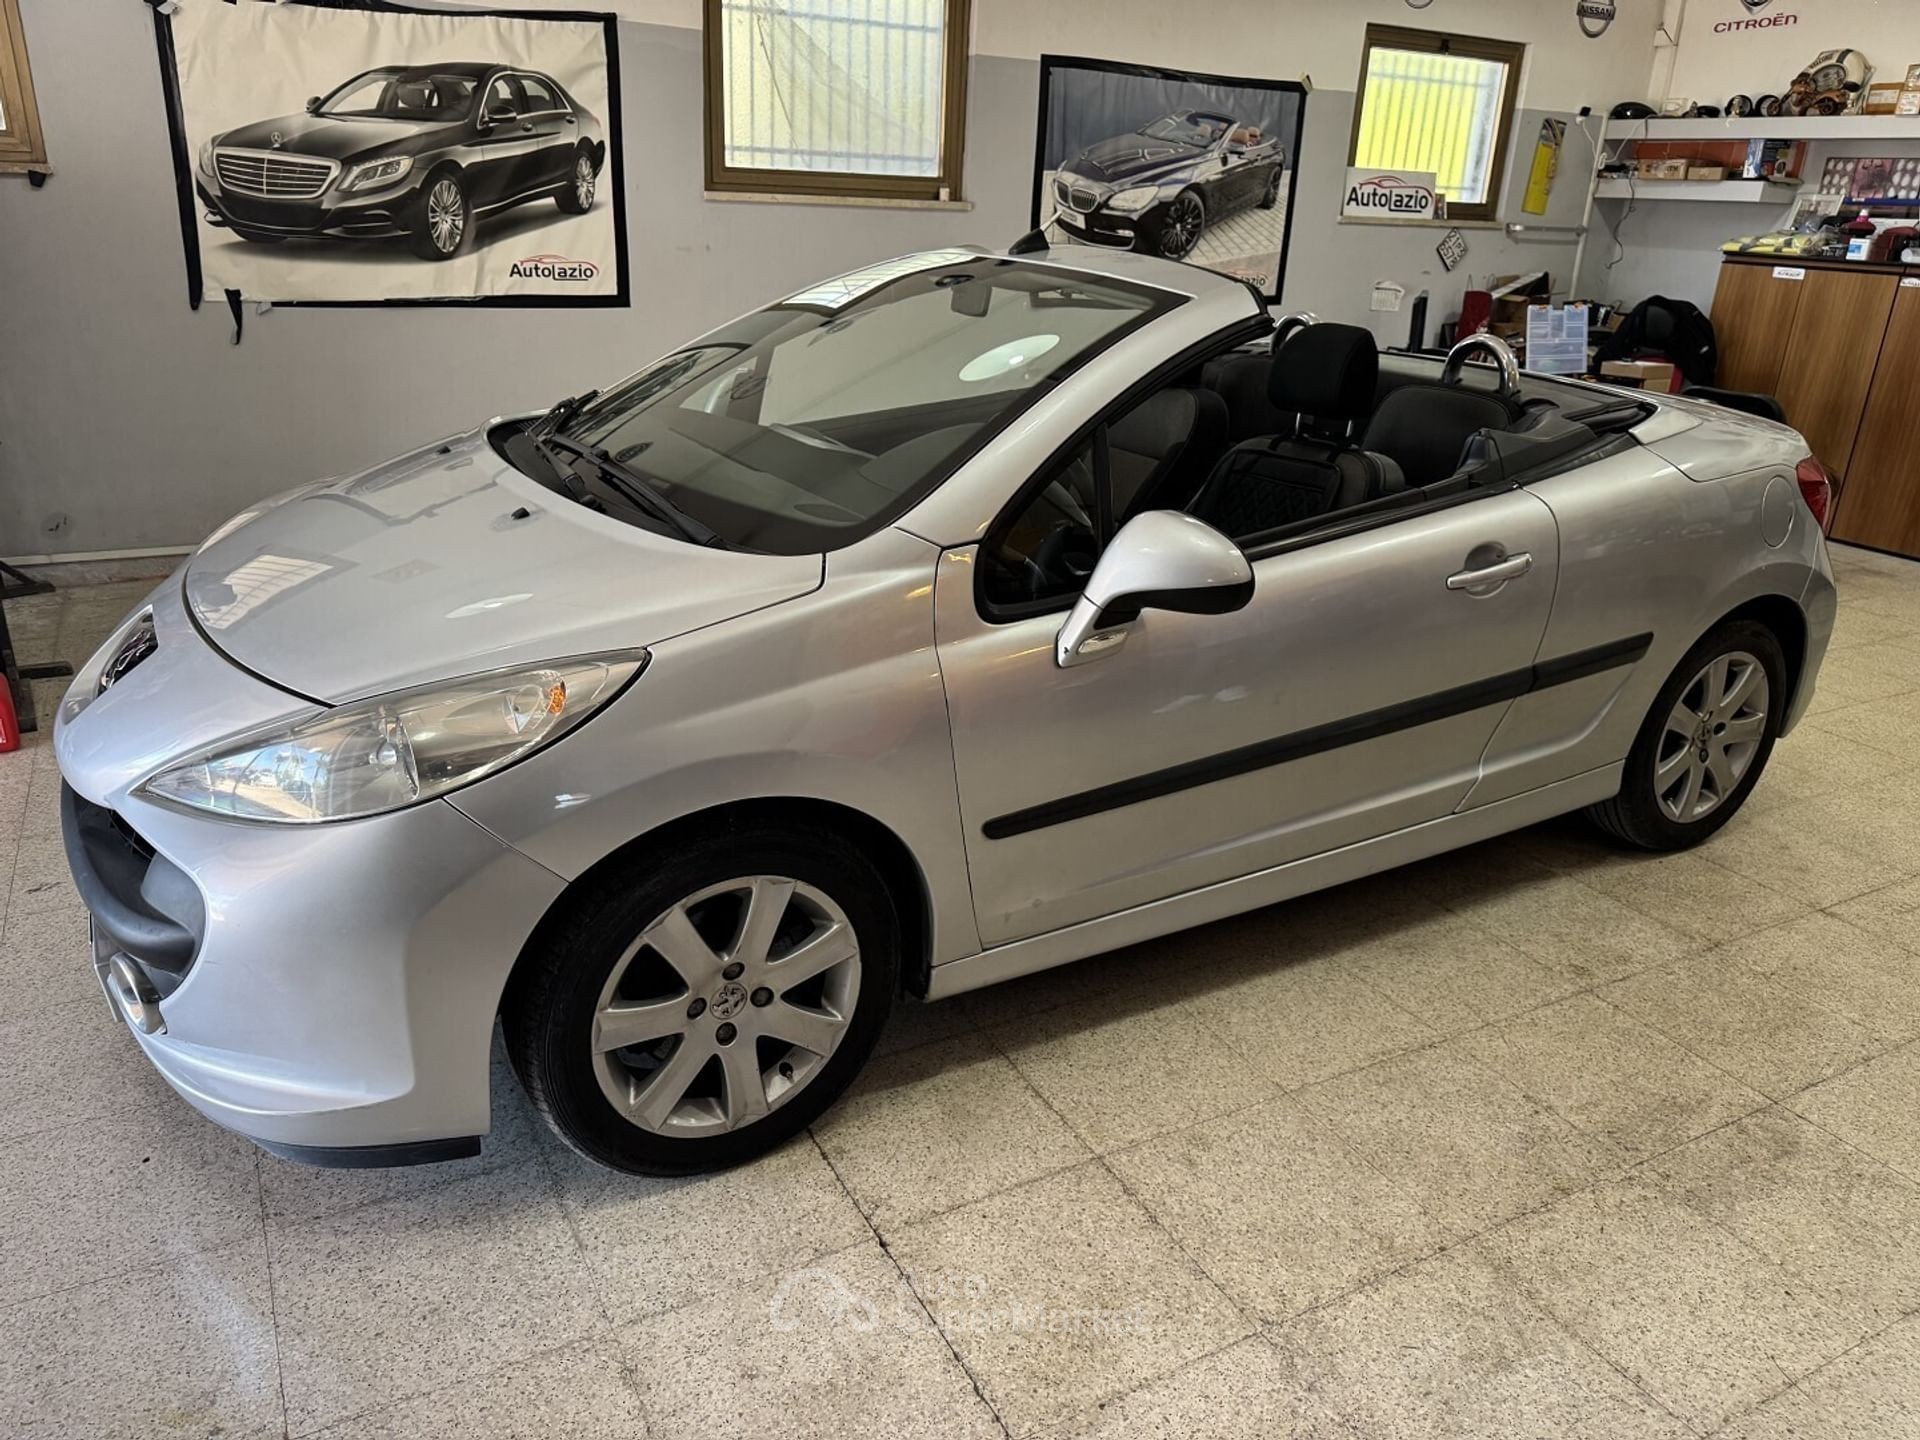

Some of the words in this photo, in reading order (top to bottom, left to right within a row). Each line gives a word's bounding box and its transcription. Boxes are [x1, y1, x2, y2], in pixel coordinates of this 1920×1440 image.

[1580, 4, 1612, 17] NISSAN
[1346, 186, 1429, 213] AutoLazio
[509, 263, 594, 281] AutoLazio
